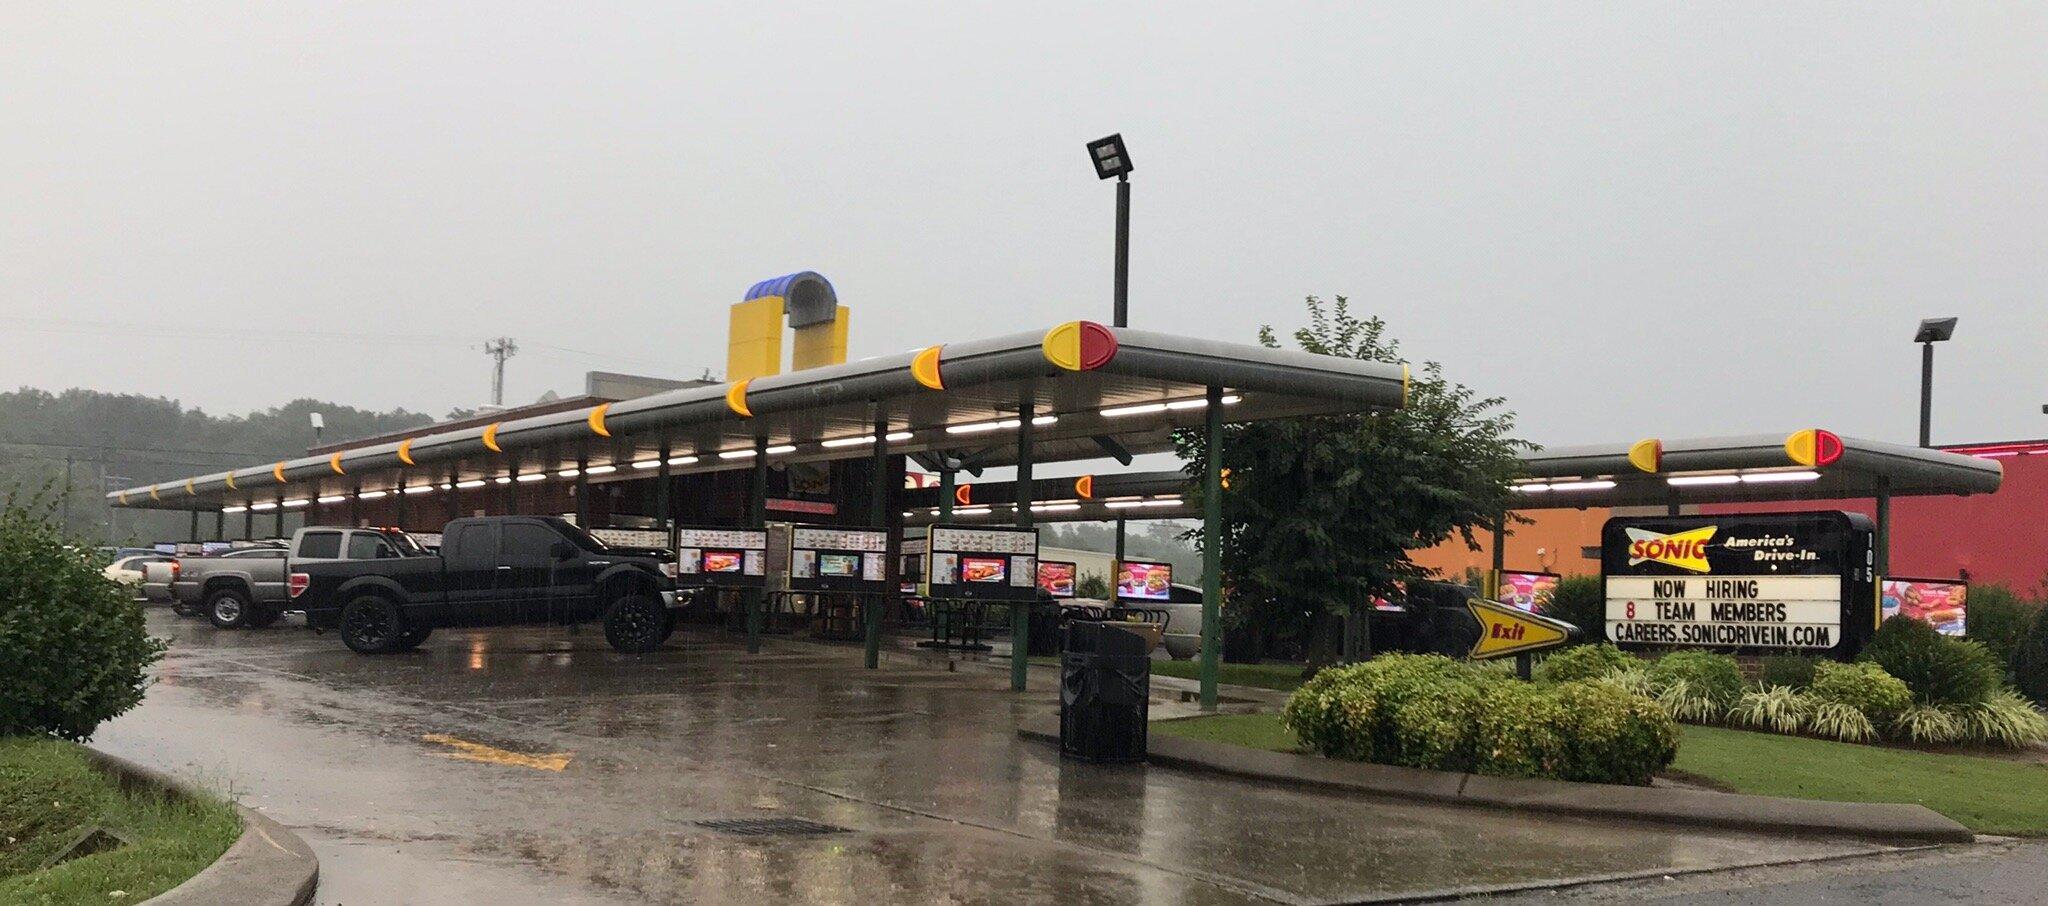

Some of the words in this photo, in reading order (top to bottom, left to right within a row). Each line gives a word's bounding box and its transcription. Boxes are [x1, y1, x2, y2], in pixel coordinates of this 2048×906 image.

[1630, 538, 1709, 560] SONIC
[1723, 533, 1795, 548] America's
[1653, 580, 1686, 599] NOW
[1706, 580, 1759, 599] HIRING
[1626, 601, 1635, 619] 8
[1656, 602, 1695, 621] TEAM
[1711, 603, 1787, 622] MEMBERS
[1491, 623, 1525, 640] Exit
[1615, 623, 1830, 647] CAREERS.SONICDRIVEIN.COM
